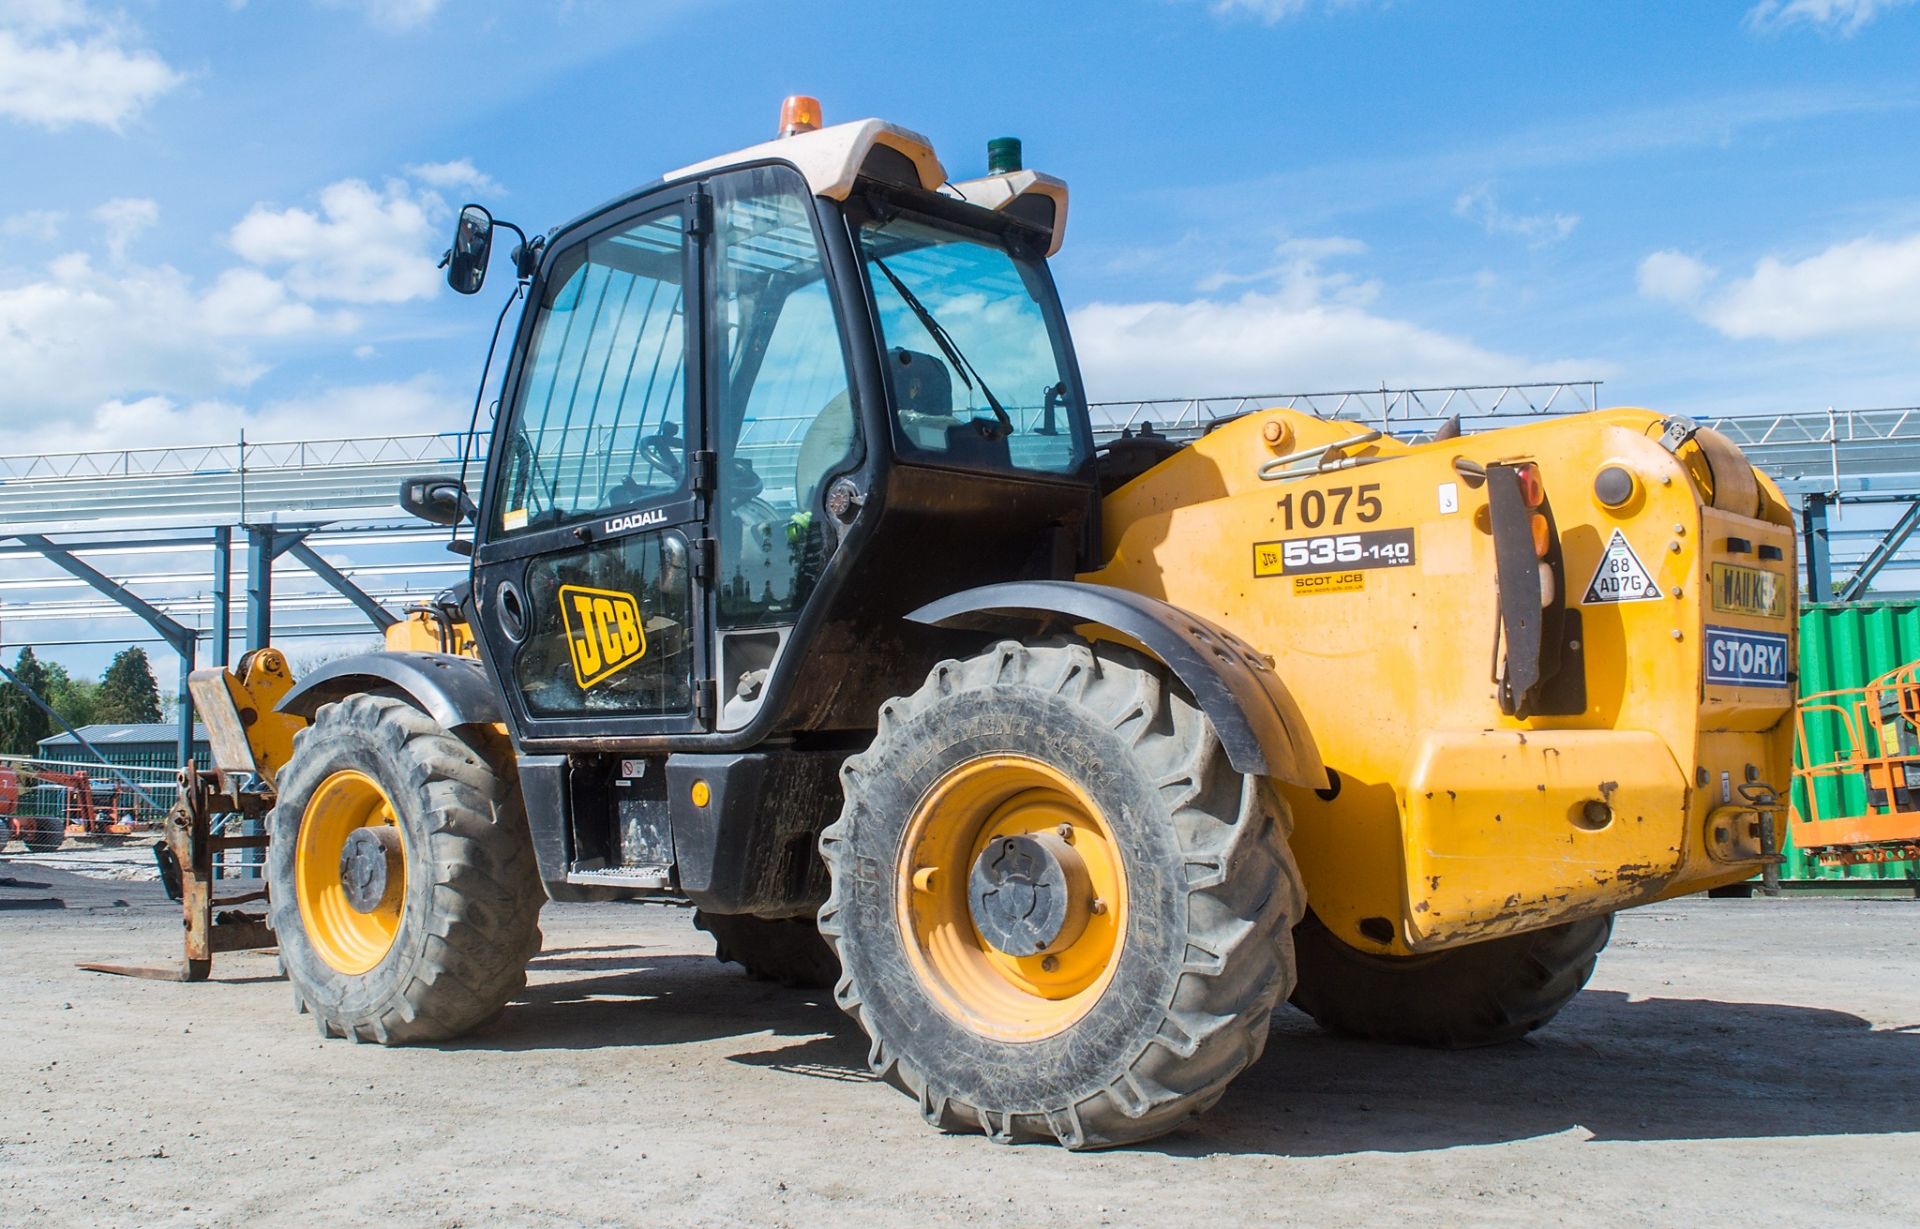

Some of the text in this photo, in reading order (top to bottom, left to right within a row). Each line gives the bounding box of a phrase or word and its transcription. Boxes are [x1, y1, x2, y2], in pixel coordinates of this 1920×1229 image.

[1277, 483, 1382, 530] 1075
[605, 509, 667, 534] LOADALL
[1262, 552, 1278, 566] JCB
[1283, 535, 1409, 567] 535-140
[1610, 558, 1630, 573] 88
[1295, 573, 1364, 587] SCOT JCB
[1600, 575, 1642, 593] AD7G
[573, 595, 640, 676] JCB
[1711, 639, 1782, 676] STORY
